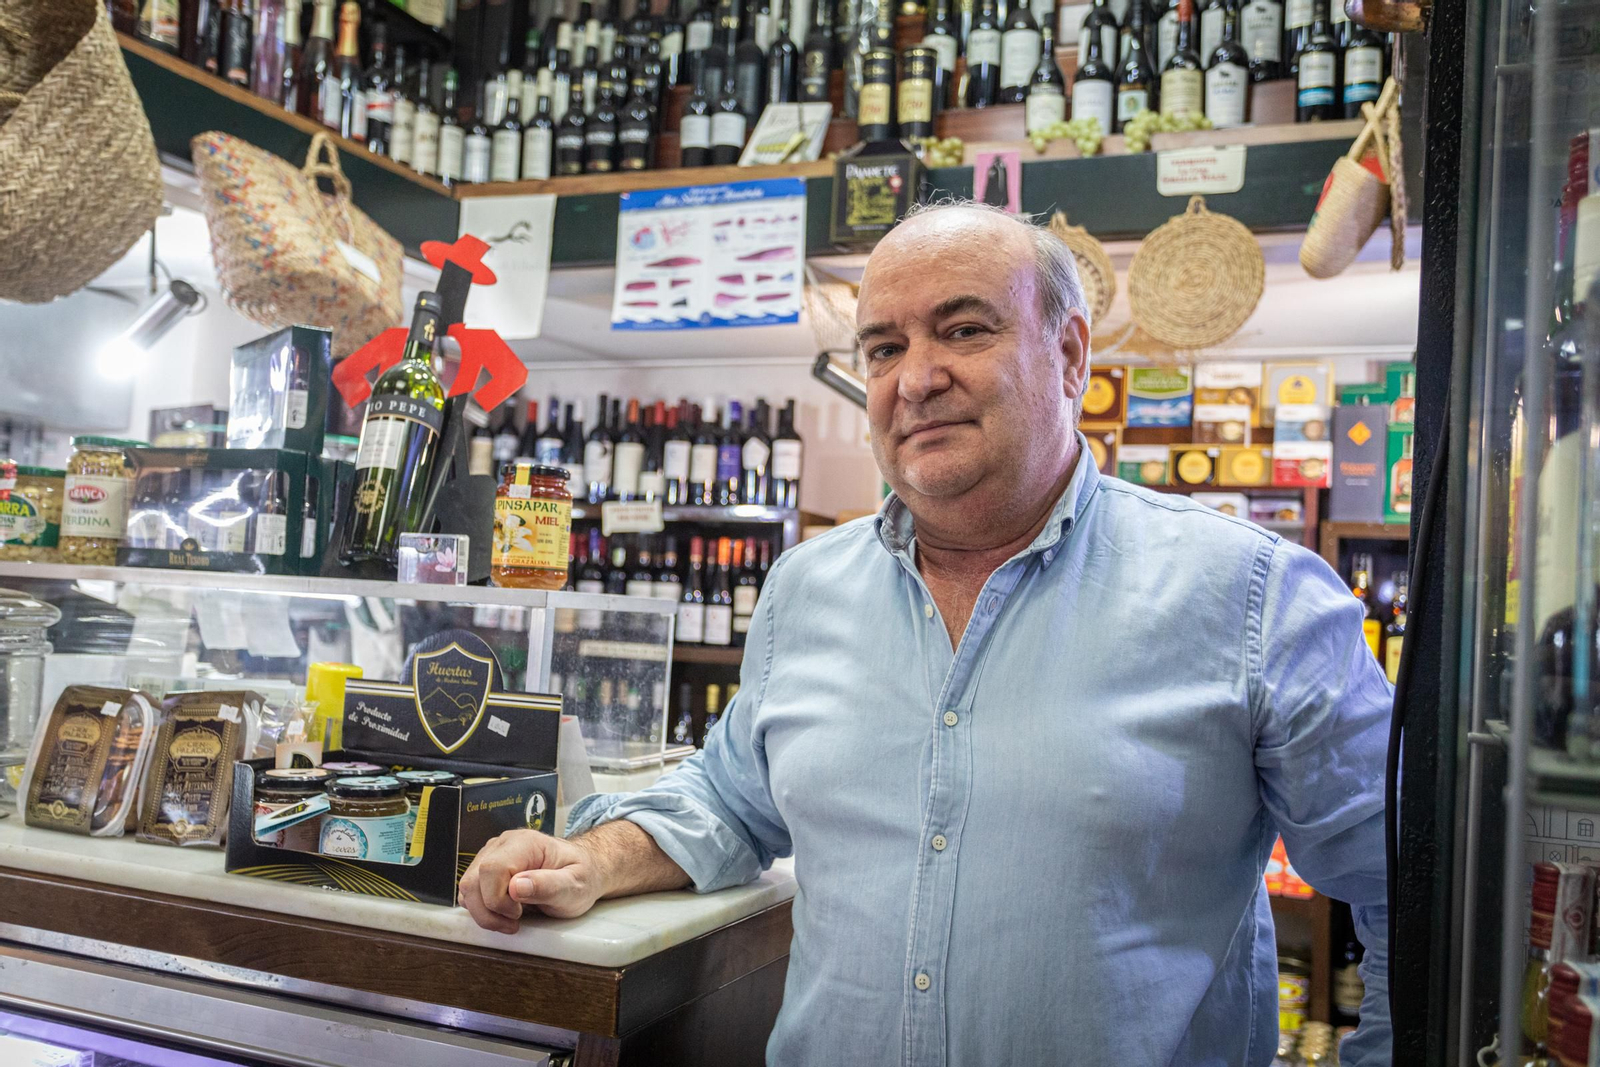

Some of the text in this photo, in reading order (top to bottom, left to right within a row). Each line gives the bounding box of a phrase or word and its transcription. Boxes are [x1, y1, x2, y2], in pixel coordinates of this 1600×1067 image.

[388, 400, 427, 418] PEPE
[0, 501, 32, 518] RRA
[497, 499, 559, 514] PINSAPAR
[534, 515, 560, 527] MIEL
[426, 661, 473, 678] Huertas
[356, 701, 392, 722] Producto
[348, 711, 410, 742] de Proximidad
[466, 801, 479, 813] Con
[480, 800, 487, 810] la
[515, 793, 523, 804] de
